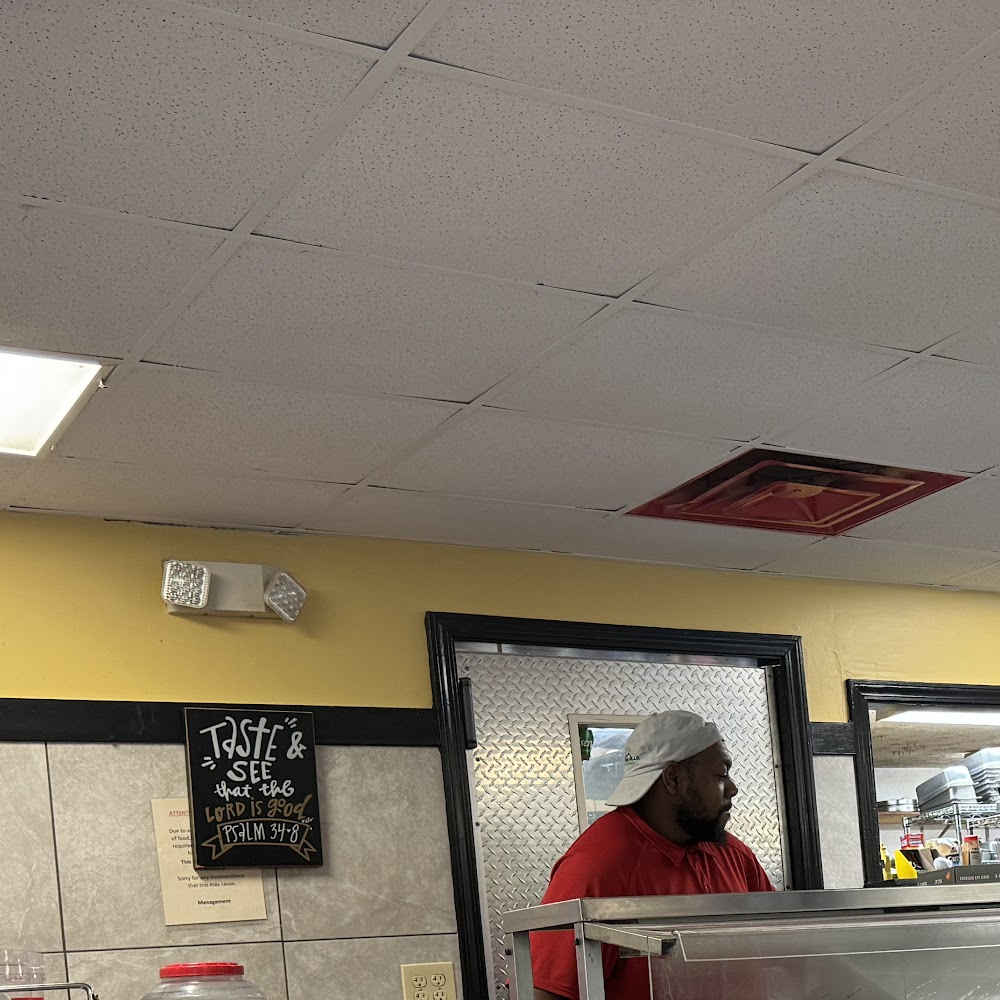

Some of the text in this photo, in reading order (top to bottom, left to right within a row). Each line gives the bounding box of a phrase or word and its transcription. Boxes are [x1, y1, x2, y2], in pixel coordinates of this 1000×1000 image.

[226, 760, 273, 784] SEE
[214, 780, 295, 801] that the
[205, 801, 246, 823] LORD
[267, 793, 313, 820] good
[197, 898, 232, 906] Management
